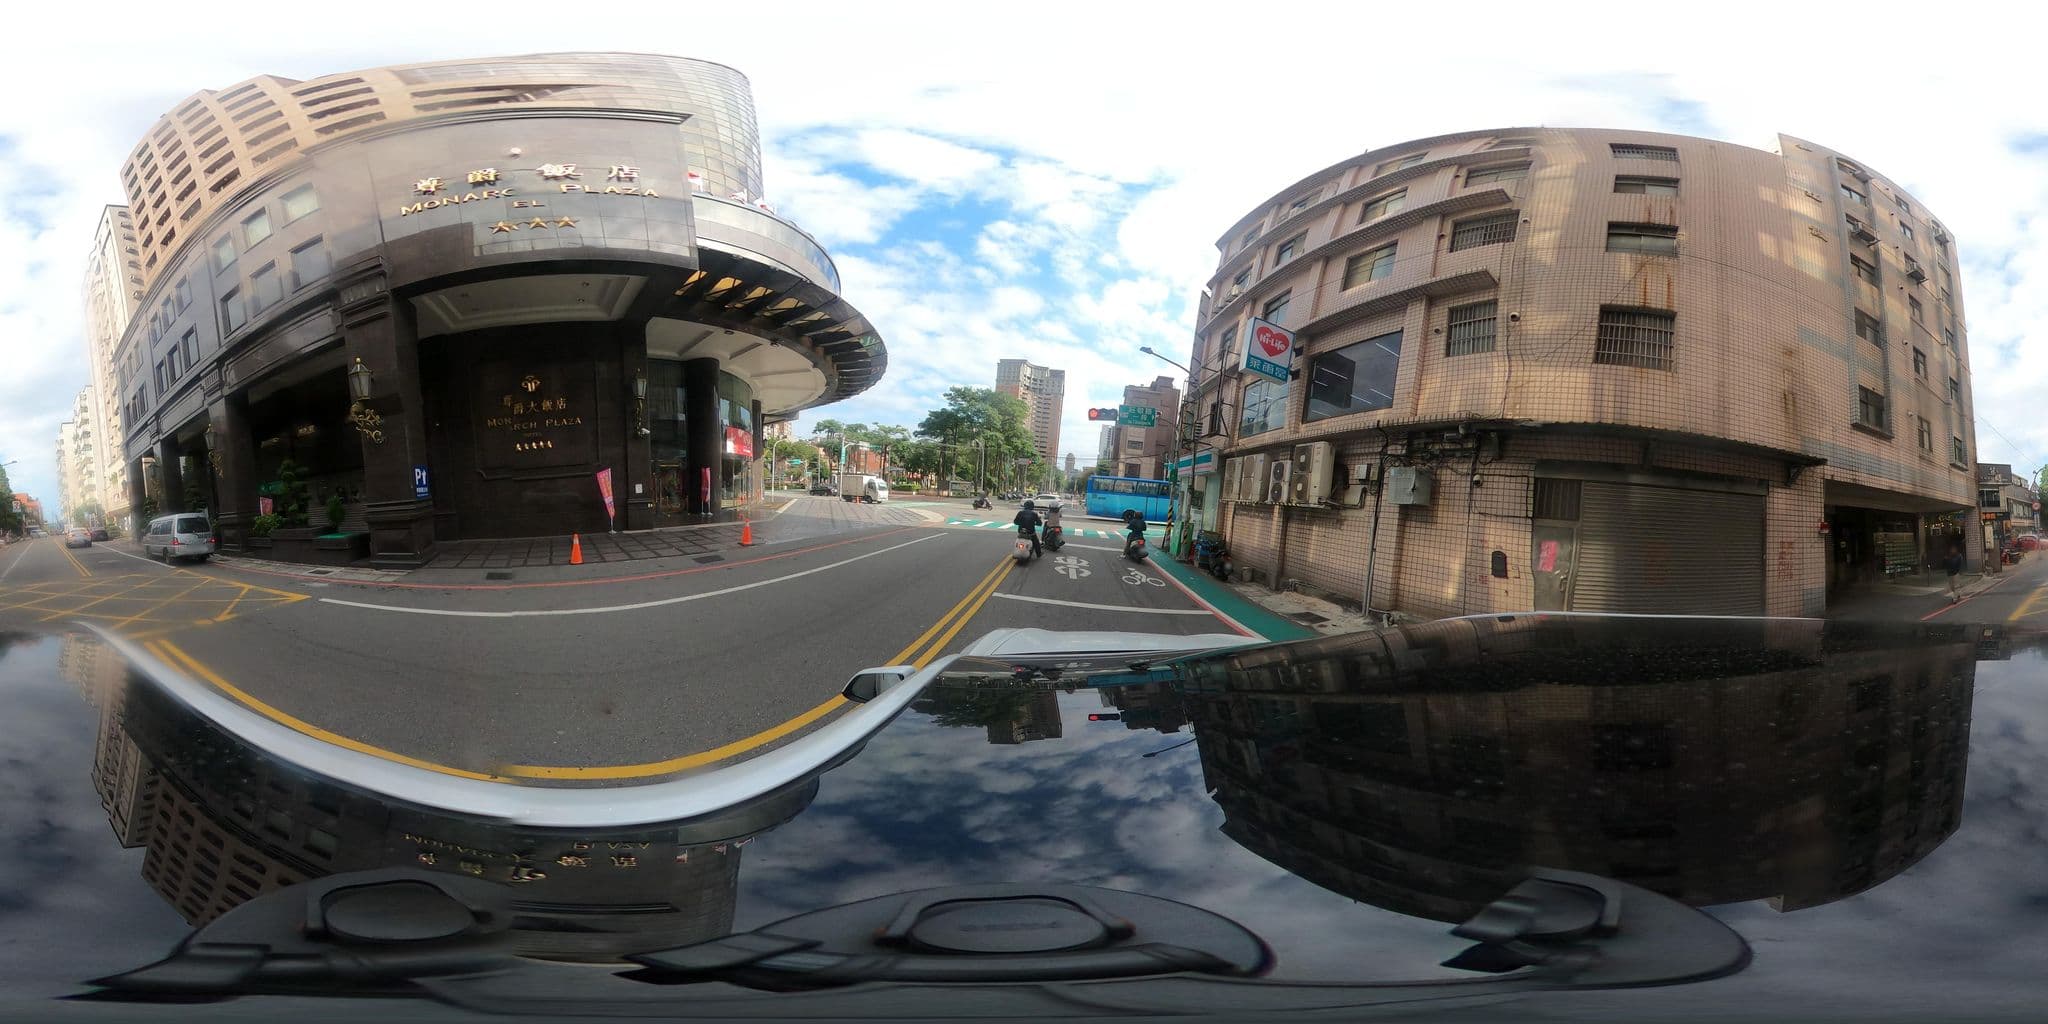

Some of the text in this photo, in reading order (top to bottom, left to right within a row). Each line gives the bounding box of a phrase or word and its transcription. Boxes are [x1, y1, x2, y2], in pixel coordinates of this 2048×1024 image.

[560, 184, 660, 198] PLAZA
[1260, 332, 1287, 351] Hi-Life
[545, 417, 581, 426] PLAZA
